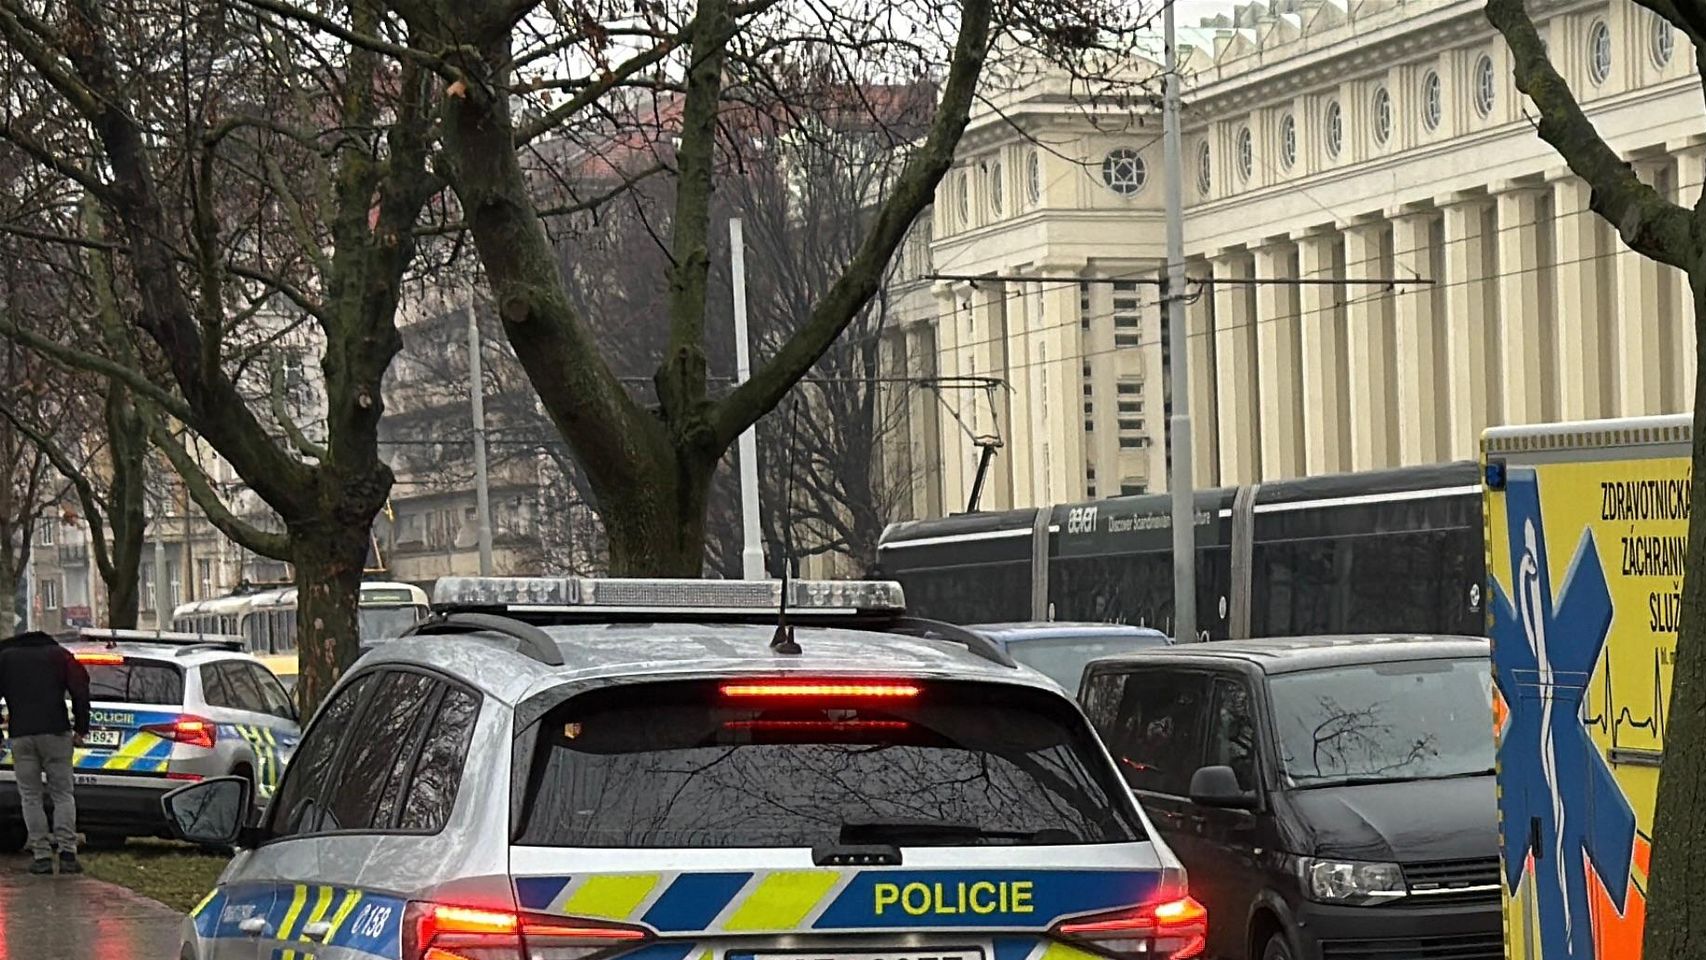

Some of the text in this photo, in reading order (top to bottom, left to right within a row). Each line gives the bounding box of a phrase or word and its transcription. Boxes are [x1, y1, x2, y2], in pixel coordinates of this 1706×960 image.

[1621, 525, 1687, 576] ZÁCHRANN
[1650, 581, 1681, 633] SLUŽ
[874, 881, 1034, 915] POLICIE
